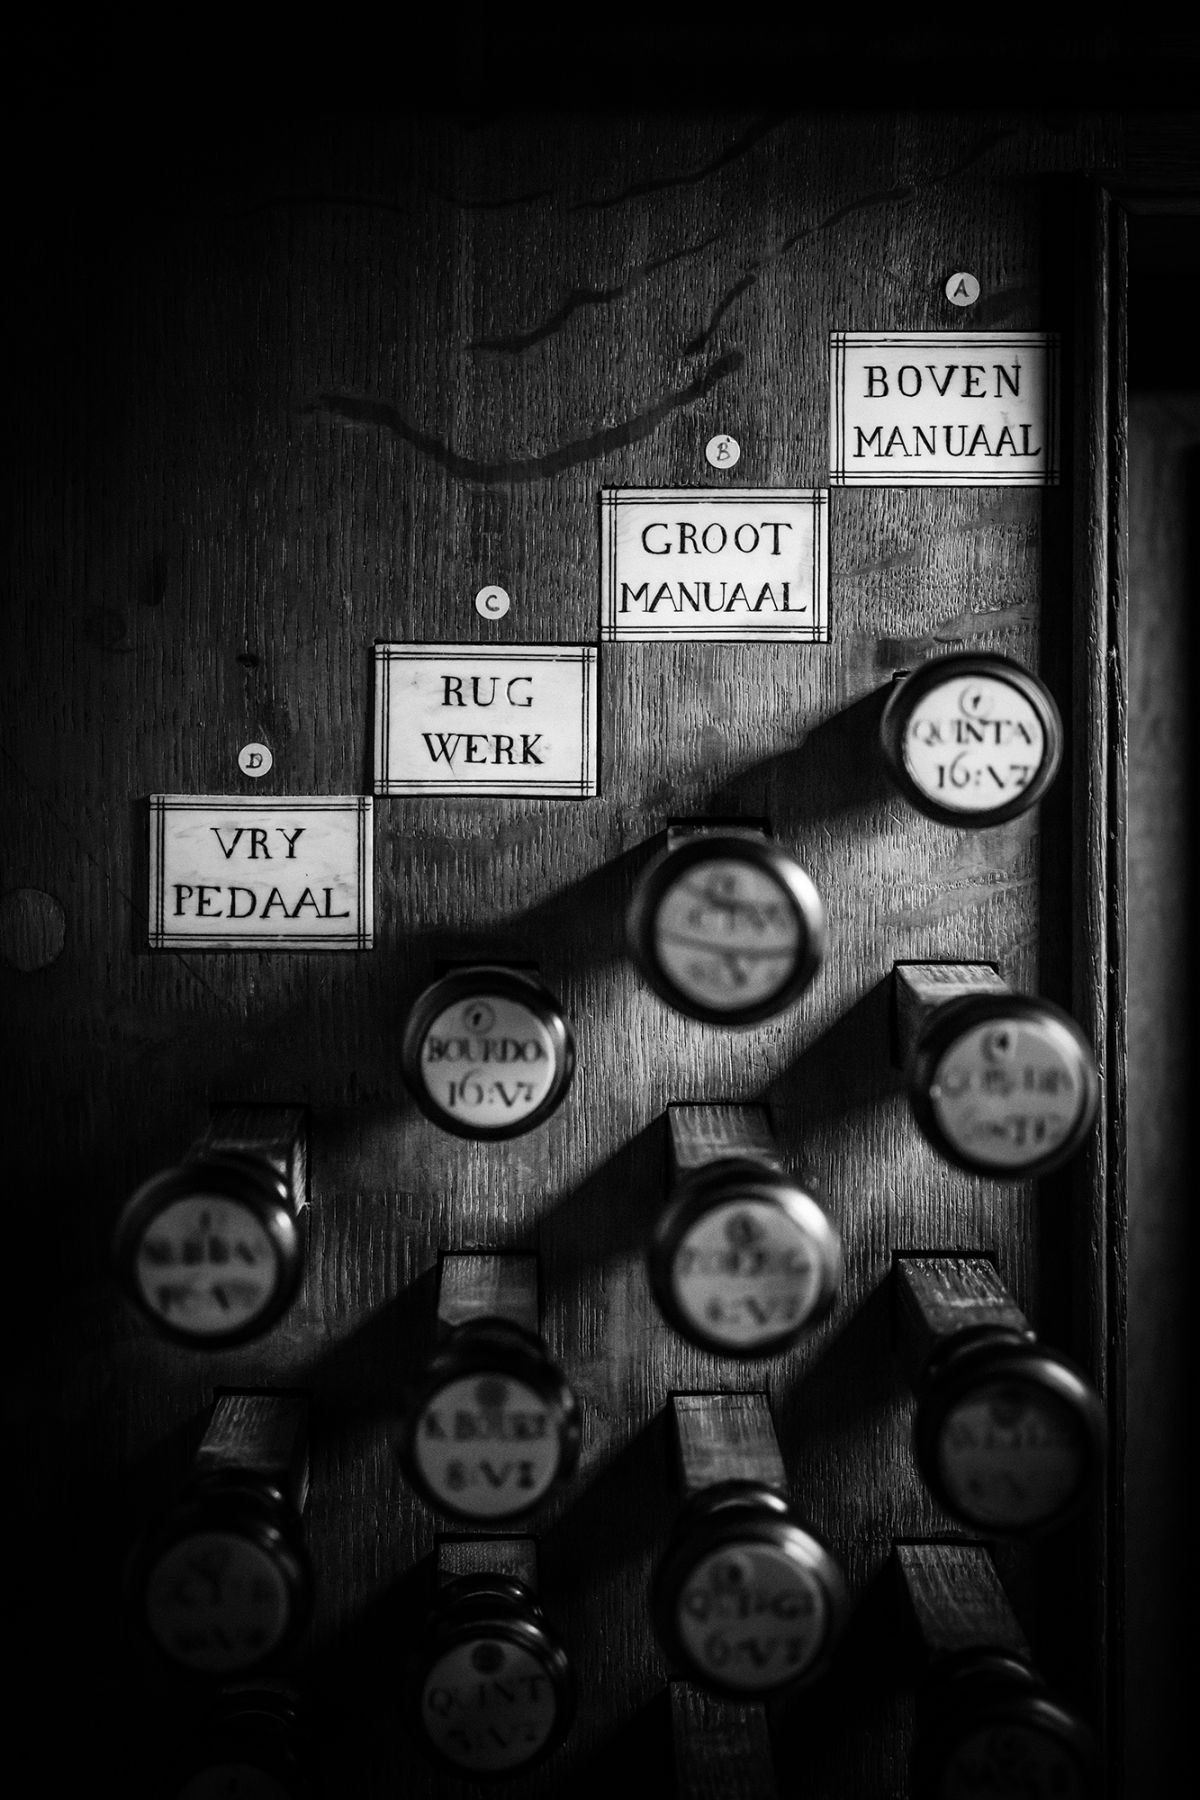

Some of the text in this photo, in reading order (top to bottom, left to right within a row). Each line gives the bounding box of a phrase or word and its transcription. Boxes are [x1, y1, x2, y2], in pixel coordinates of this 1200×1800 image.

[953, 278, 970, 298] A
[863, 363, 1022, 398] BOVEN
[716, 441, 731, 461] B
[853, 424, 1042, 458] MANUAAL
[641, 522, 793, 555] GROOT
[485, 594, 500, 612] C
[618, 581, 808, 613] MANUAAL
[440, 675, 534, 708] RUG
[245, 752, 263, 769] D
[421, 732, 545, 766] WERK
[209, 827, 307, 860] VRY
[173, 884, 351, 918] PEDAAL
